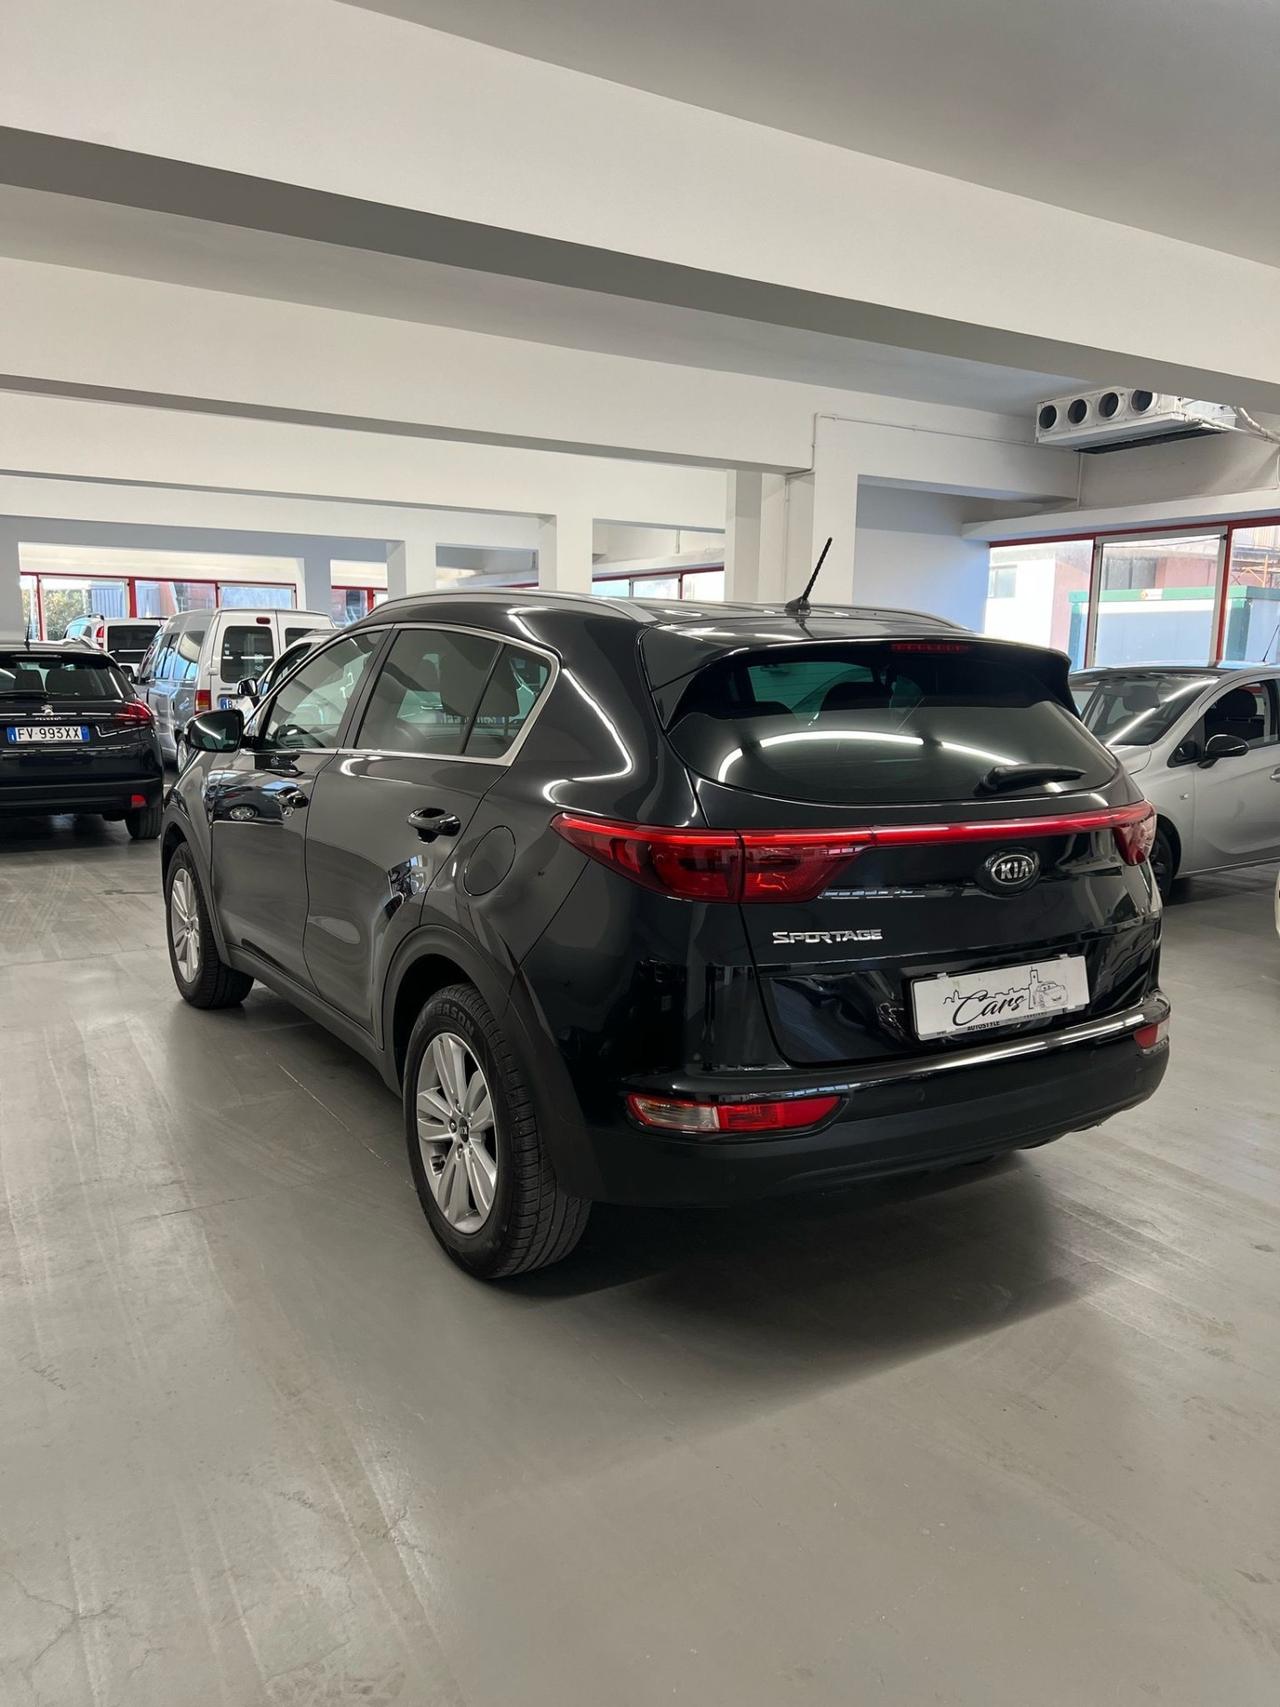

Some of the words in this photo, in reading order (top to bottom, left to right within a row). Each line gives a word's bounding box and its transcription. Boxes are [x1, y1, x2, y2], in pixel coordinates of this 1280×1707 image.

[1000, 860, 1030, 879] KIA
[772, 929, 883, 944] SPORTAGE
[952, 989, 1025, 1026] Cars
